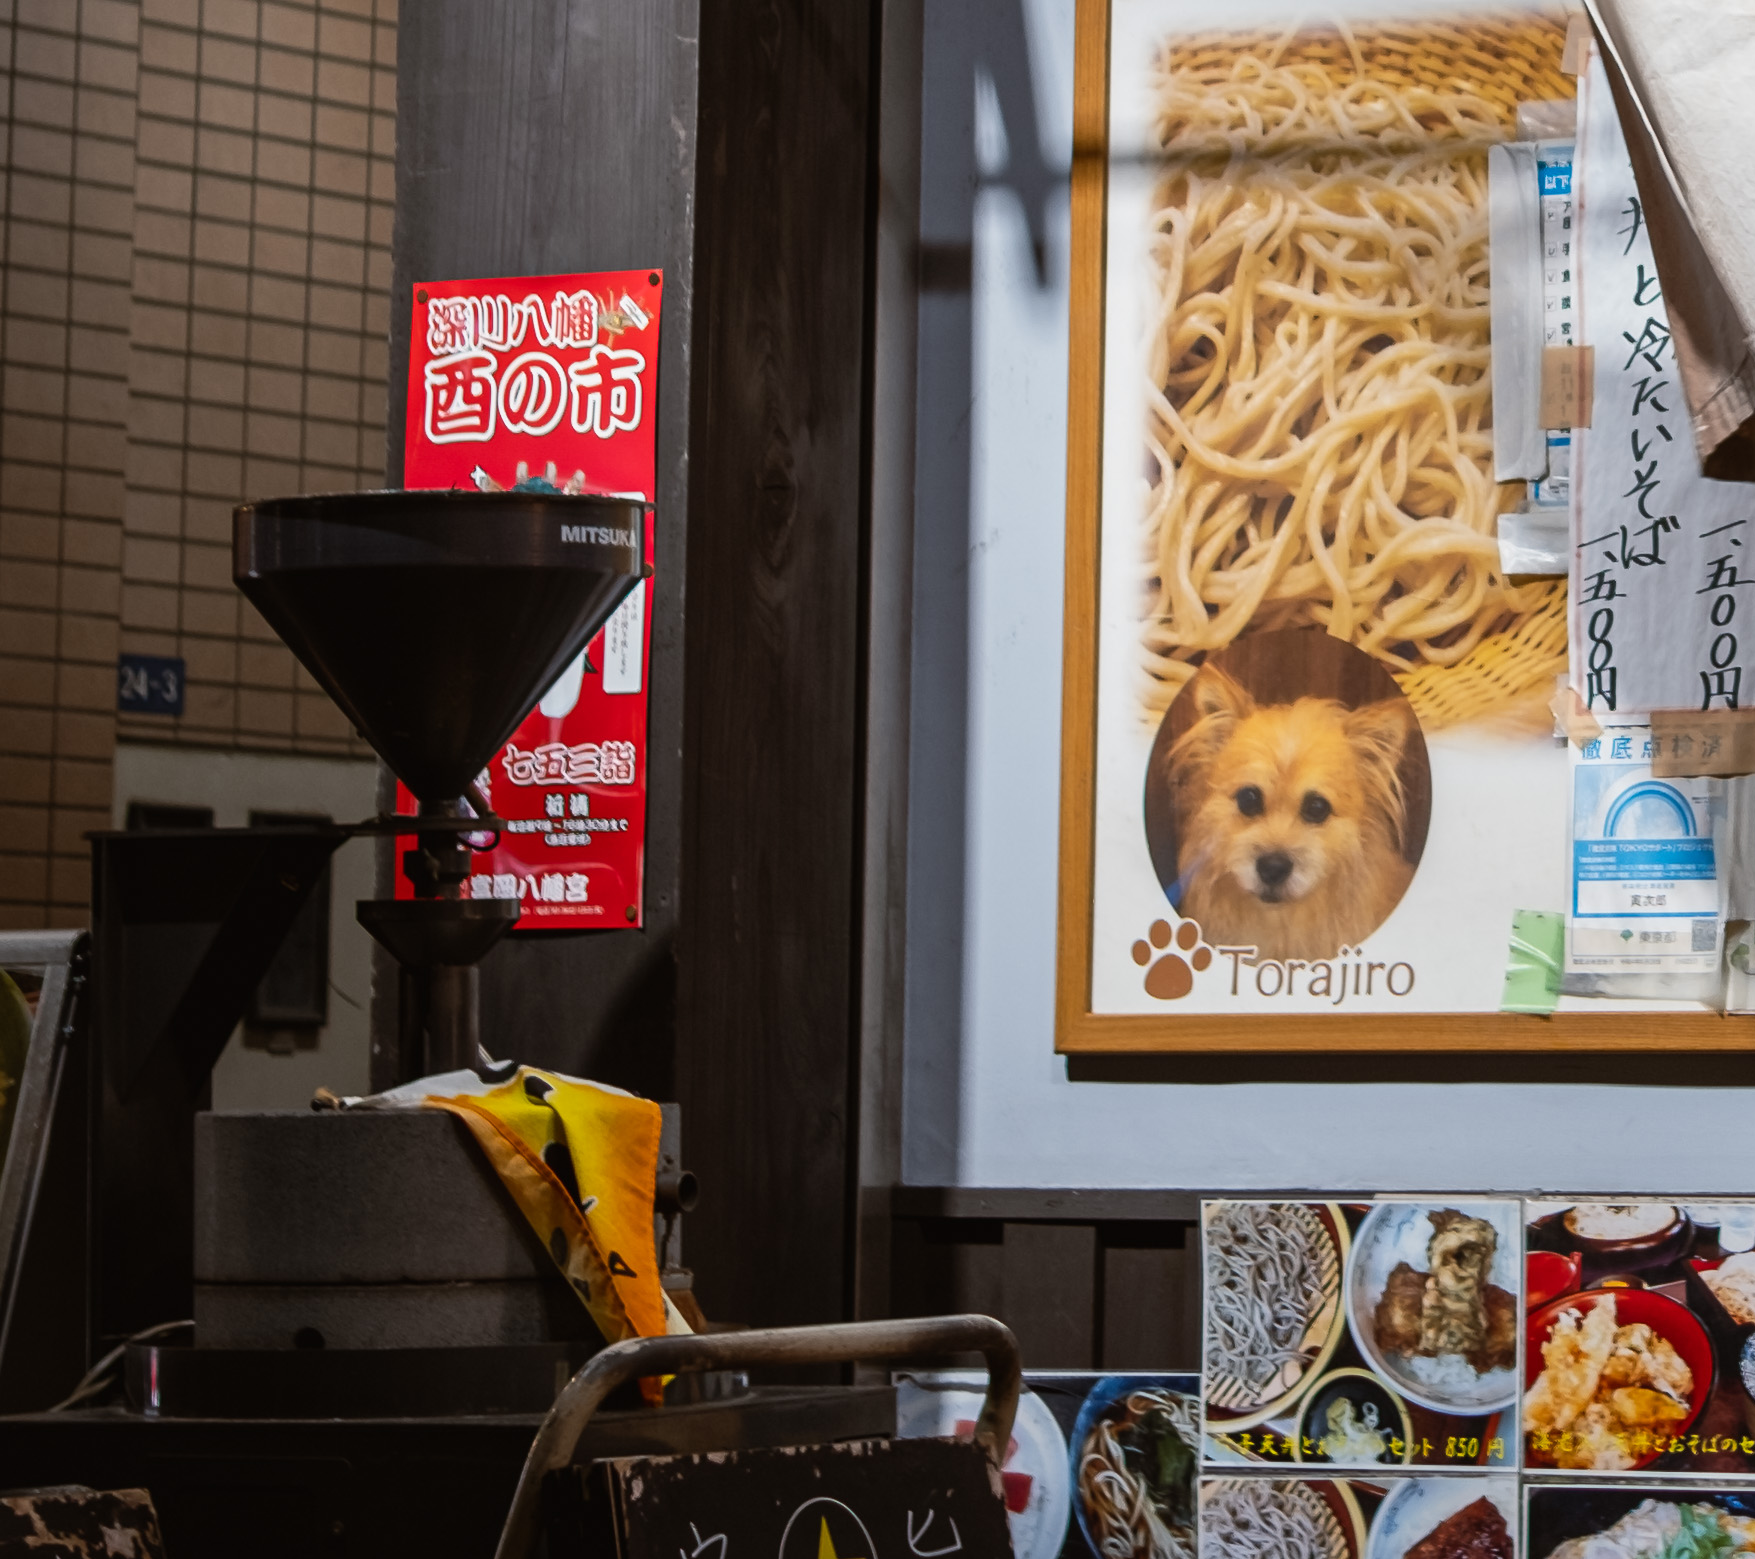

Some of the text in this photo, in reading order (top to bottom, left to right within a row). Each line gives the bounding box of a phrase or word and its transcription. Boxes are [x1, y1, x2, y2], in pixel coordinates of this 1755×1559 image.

[427, 289, 598, 355] 深川八幡
[424, 343, 646, 445] 酉の市
[502, 741, 637, 786] 七五三詣
[1218, 945, 1416, 1005] Torajiro
[1445, 1436, 1478, 1458] 850
[1486, 1437, 1505, 1459] 円
